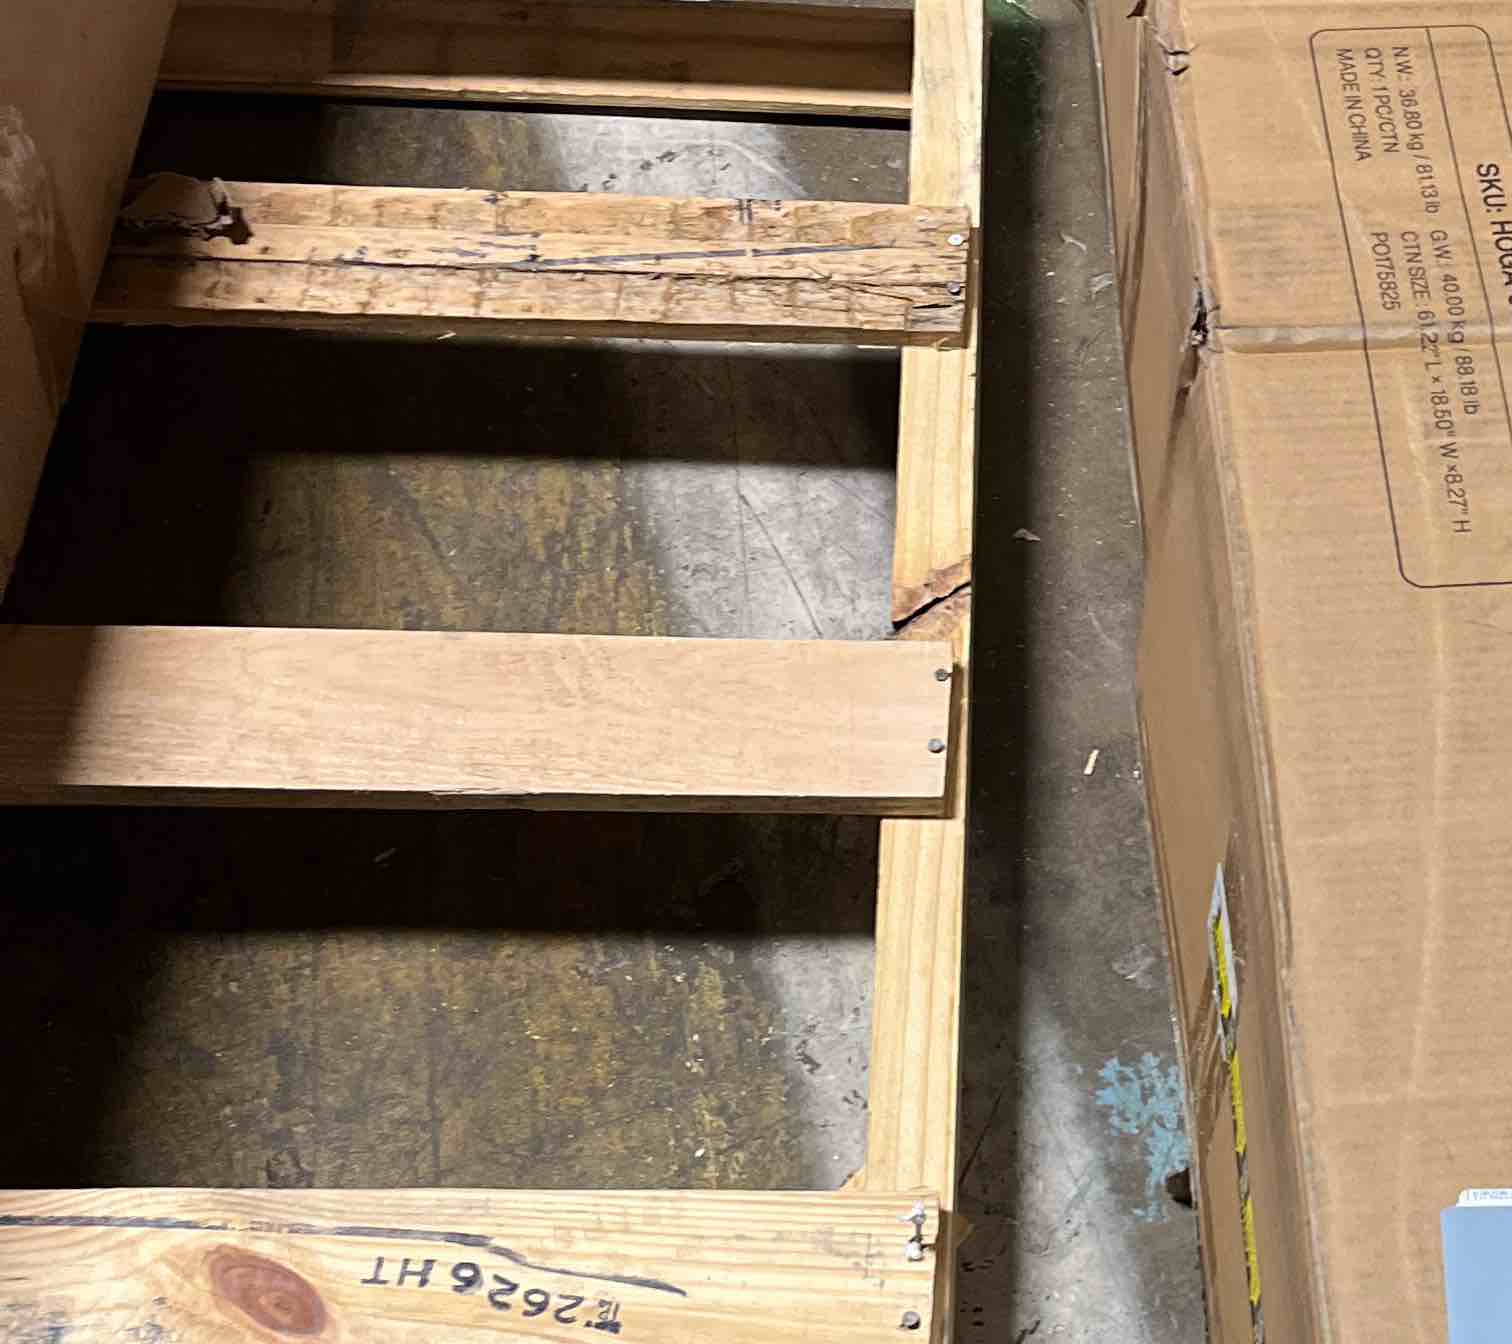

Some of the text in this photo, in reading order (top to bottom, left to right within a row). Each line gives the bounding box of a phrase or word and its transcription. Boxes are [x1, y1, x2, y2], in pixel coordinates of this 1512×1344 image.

[1336, 48, 1372, 161] MADE IN CHINA
[1406, 133, 1424, 150] kg
[1476, 162, 1508, 214] SKU:
[1442, 273, 1465, 317] 40.00
[1455, 355, 1479, 397] 88.18
[1400, 230, 1423, 264] CTN
[1439, 441, 1459, 460] W
[1452, 520, 1472, 533] H
[360, 1256, 437, 1288] HT
